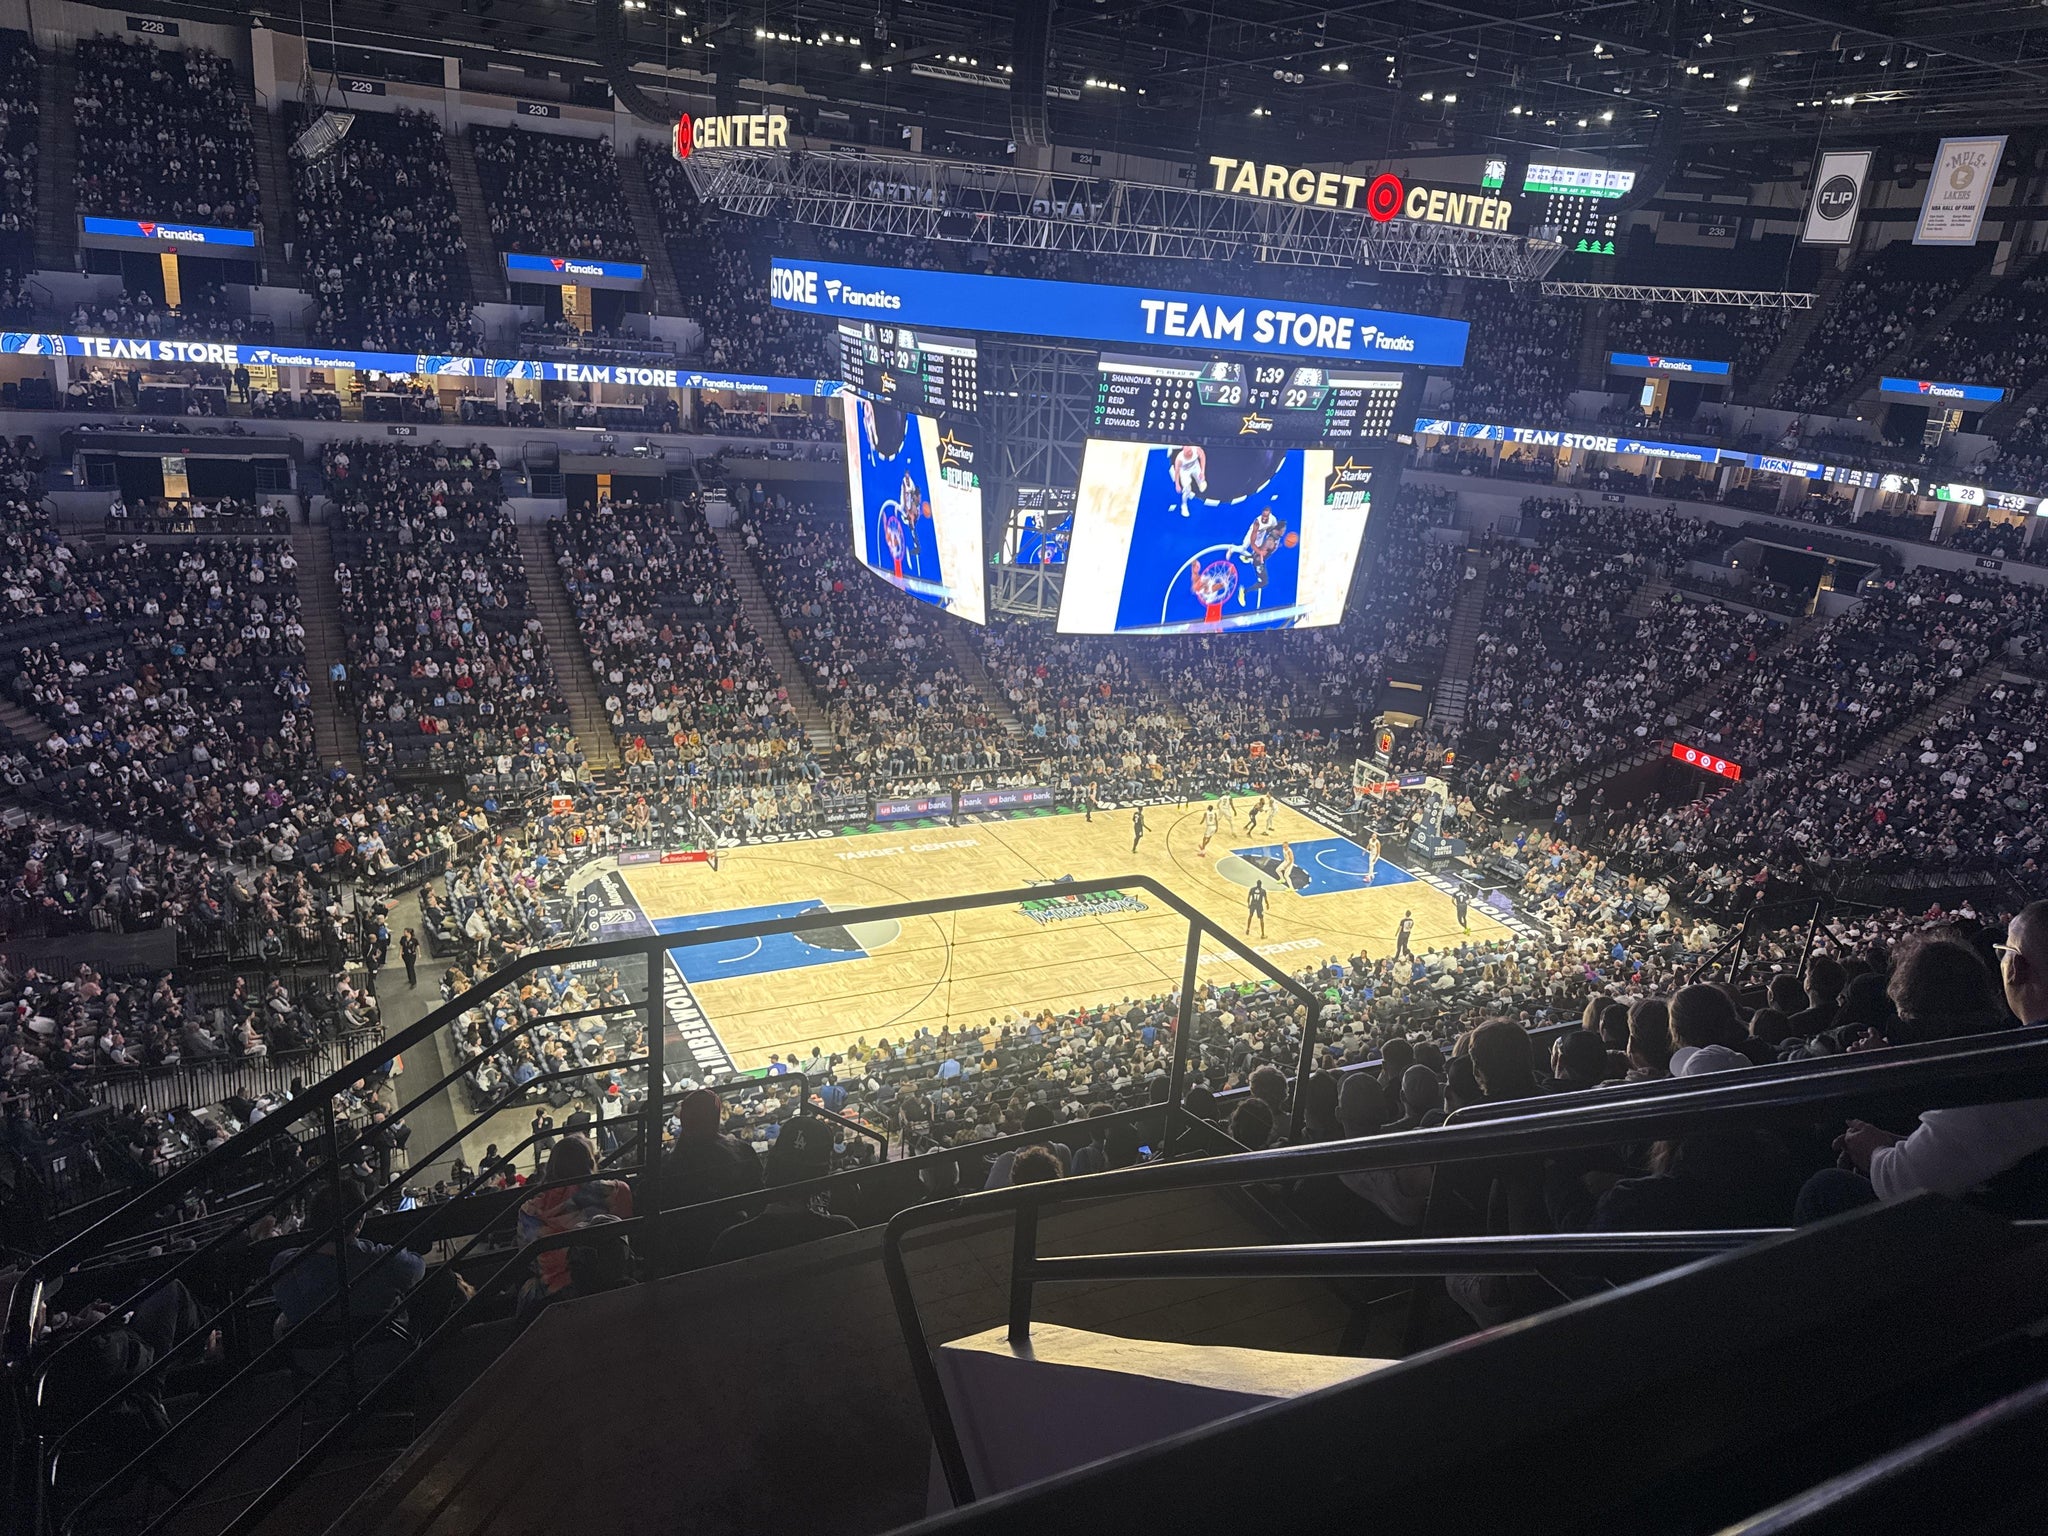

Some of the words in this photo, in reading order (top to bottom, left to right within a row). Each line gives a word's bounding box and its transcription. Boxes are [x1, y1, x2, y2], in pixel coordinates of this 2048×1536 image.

[141, 20, 165, 33] 228
[351, 81, 373, 94] 229
[528, 104, 549, 116] 230
[692, 114, 788, 149] CENTER
[1951, 151, 1985, 169] MPLS
[1210, 156, 1366, 209] TARGET
[1406, 187, 1512, 231] CENTER
[1821, 191, 1853, 205] FLIP
[1943, 190, 1971, 200] LAKERS
[157, 226, 205, 242] Fanatics
[1708, 227, 1726, 237] 238
[565, 262, 603, 276] Fanatics
[773, 269, 818, 305] STORE
[842, 285, 901, 310] Fanatics
[1140, 299, 1245, 342] TEAM
[1253, 310, 1355, 350] STORE
[1375, 331, 1414, 352] Fanatics
[879, 328, 894, 344] 1:39
[78, 337, 152, 361] TEAM
[158, 341, 239, 364] STORE
[271, 353, 313, 366] Fanatics
[314, 356, 356, 368] Experience
[868, 345, 879, 363] 28
[896, 351, 909, 369] 29
[1658, 358, 1693, 372] Fanatics
[553, 363, 610, 383] TEAM
[615, 367, 678, 387] STORE
[702, 378, 735, 389] Fanatics
[735, 382, 768, 392] Experience
[1103, 373, 1107, 381] 1
[1111, 374, 1144, 384] SHANNON
[1155, 378, 1161, 386] 0
[1166, 379, 1172, 387] 0
[1187, 380, 1194, 388] 0
[1256, 367, 1285, 384] 1:39
[1099, 384, 1108, 392] 10
[1110, 385, 1140, 395] CONLEY
[1185, 391, 1192, 399] 0
[1217, 385, 1241, 404] 28
[1371, 390, 1376, 398] 2
[1379, 390, 1383, 398] 0
[1386, 390, 1391, 398] 0
[1393, 390, 1398, 398] 0
[1928, 384, 1965, 398] Fanatics
[1098, 395, 1105, 403] 11
[1108, 396, 1125, 404] REID
[1151, 400, 1158, 408] 0
[1173, 401, 1179, 409] 0
[1249, 396, 1256, 404] 6
[1270, 396, 1277, 405] 6
[1285, 390, 1308, 407] 29
[1368, 400, 1373, 408] 0
[1376, 400, 1381, 408] 2
[1384, 400, 1388, 408] 0
[1390, 400, 1396, 408] 0
[1094, 406, 1105, 414] 30
[1106, 407, 1135, 416] RANDLE
[1149, 410, 1155, 418] 6
[1160, 411, 1166, 419] 3
[1170, 412, 1176, 420] 2
[1181, 412, 1188, 420] 0
[1325, 409, 1334, 417] 30
[394, 426, 410, 435] 129
[1095, 417, 1101, 425] 5
[1105, 418, 1140, 428] EDWARDS
[1147, 421, 1153, 429] 7
[1158, 422, 1164, 430] 0
[1169, 422, 1175, 430] 3
[1180, 423, 1185, 431] 1
[1248, 420, 1273, 431] Starkey
[599, 434, 614, 443] 130
[1329, 429, 1352, 437] BROWN
[1368, 429, 1373, 437] 3
[1376, 429, 1381, 437] 2
[776, 442, 789, 450] 131
[1512, 428, 1560, 446] TEAM
[1562, 433, 1619, 453] STORE
[1639, 445, 1669, 456] Fanatics
[1670, 450, 1702, 460] Experience
[947, 444, 974, 463] Starkey
[1760, 457, 1791, 472] KFAN
[947, 467, 973, 490] REPLAY
[1341, 470, 1372, 484] Starkey
[1332, 490, 1366, 510] REPLAY
[1960, 488, 1975, 500] 28
[1998, 494, 2026, 510] 1:39
[1982, 560, 1996, 568] 101
[964, 798, 982, 806] bank
[999, 795, 1017, 803] bank
[1033, 792, 1050, 800] bank
[892, 804, 911, 813] bank
[928, 800, 947, 810] bank
[746, 828, 834, 845] sezzle
[910, 839, 981, 852] CENTER
[835, 846, 905, 861] TARGET
[568, 959, 598, 971] ENTER
